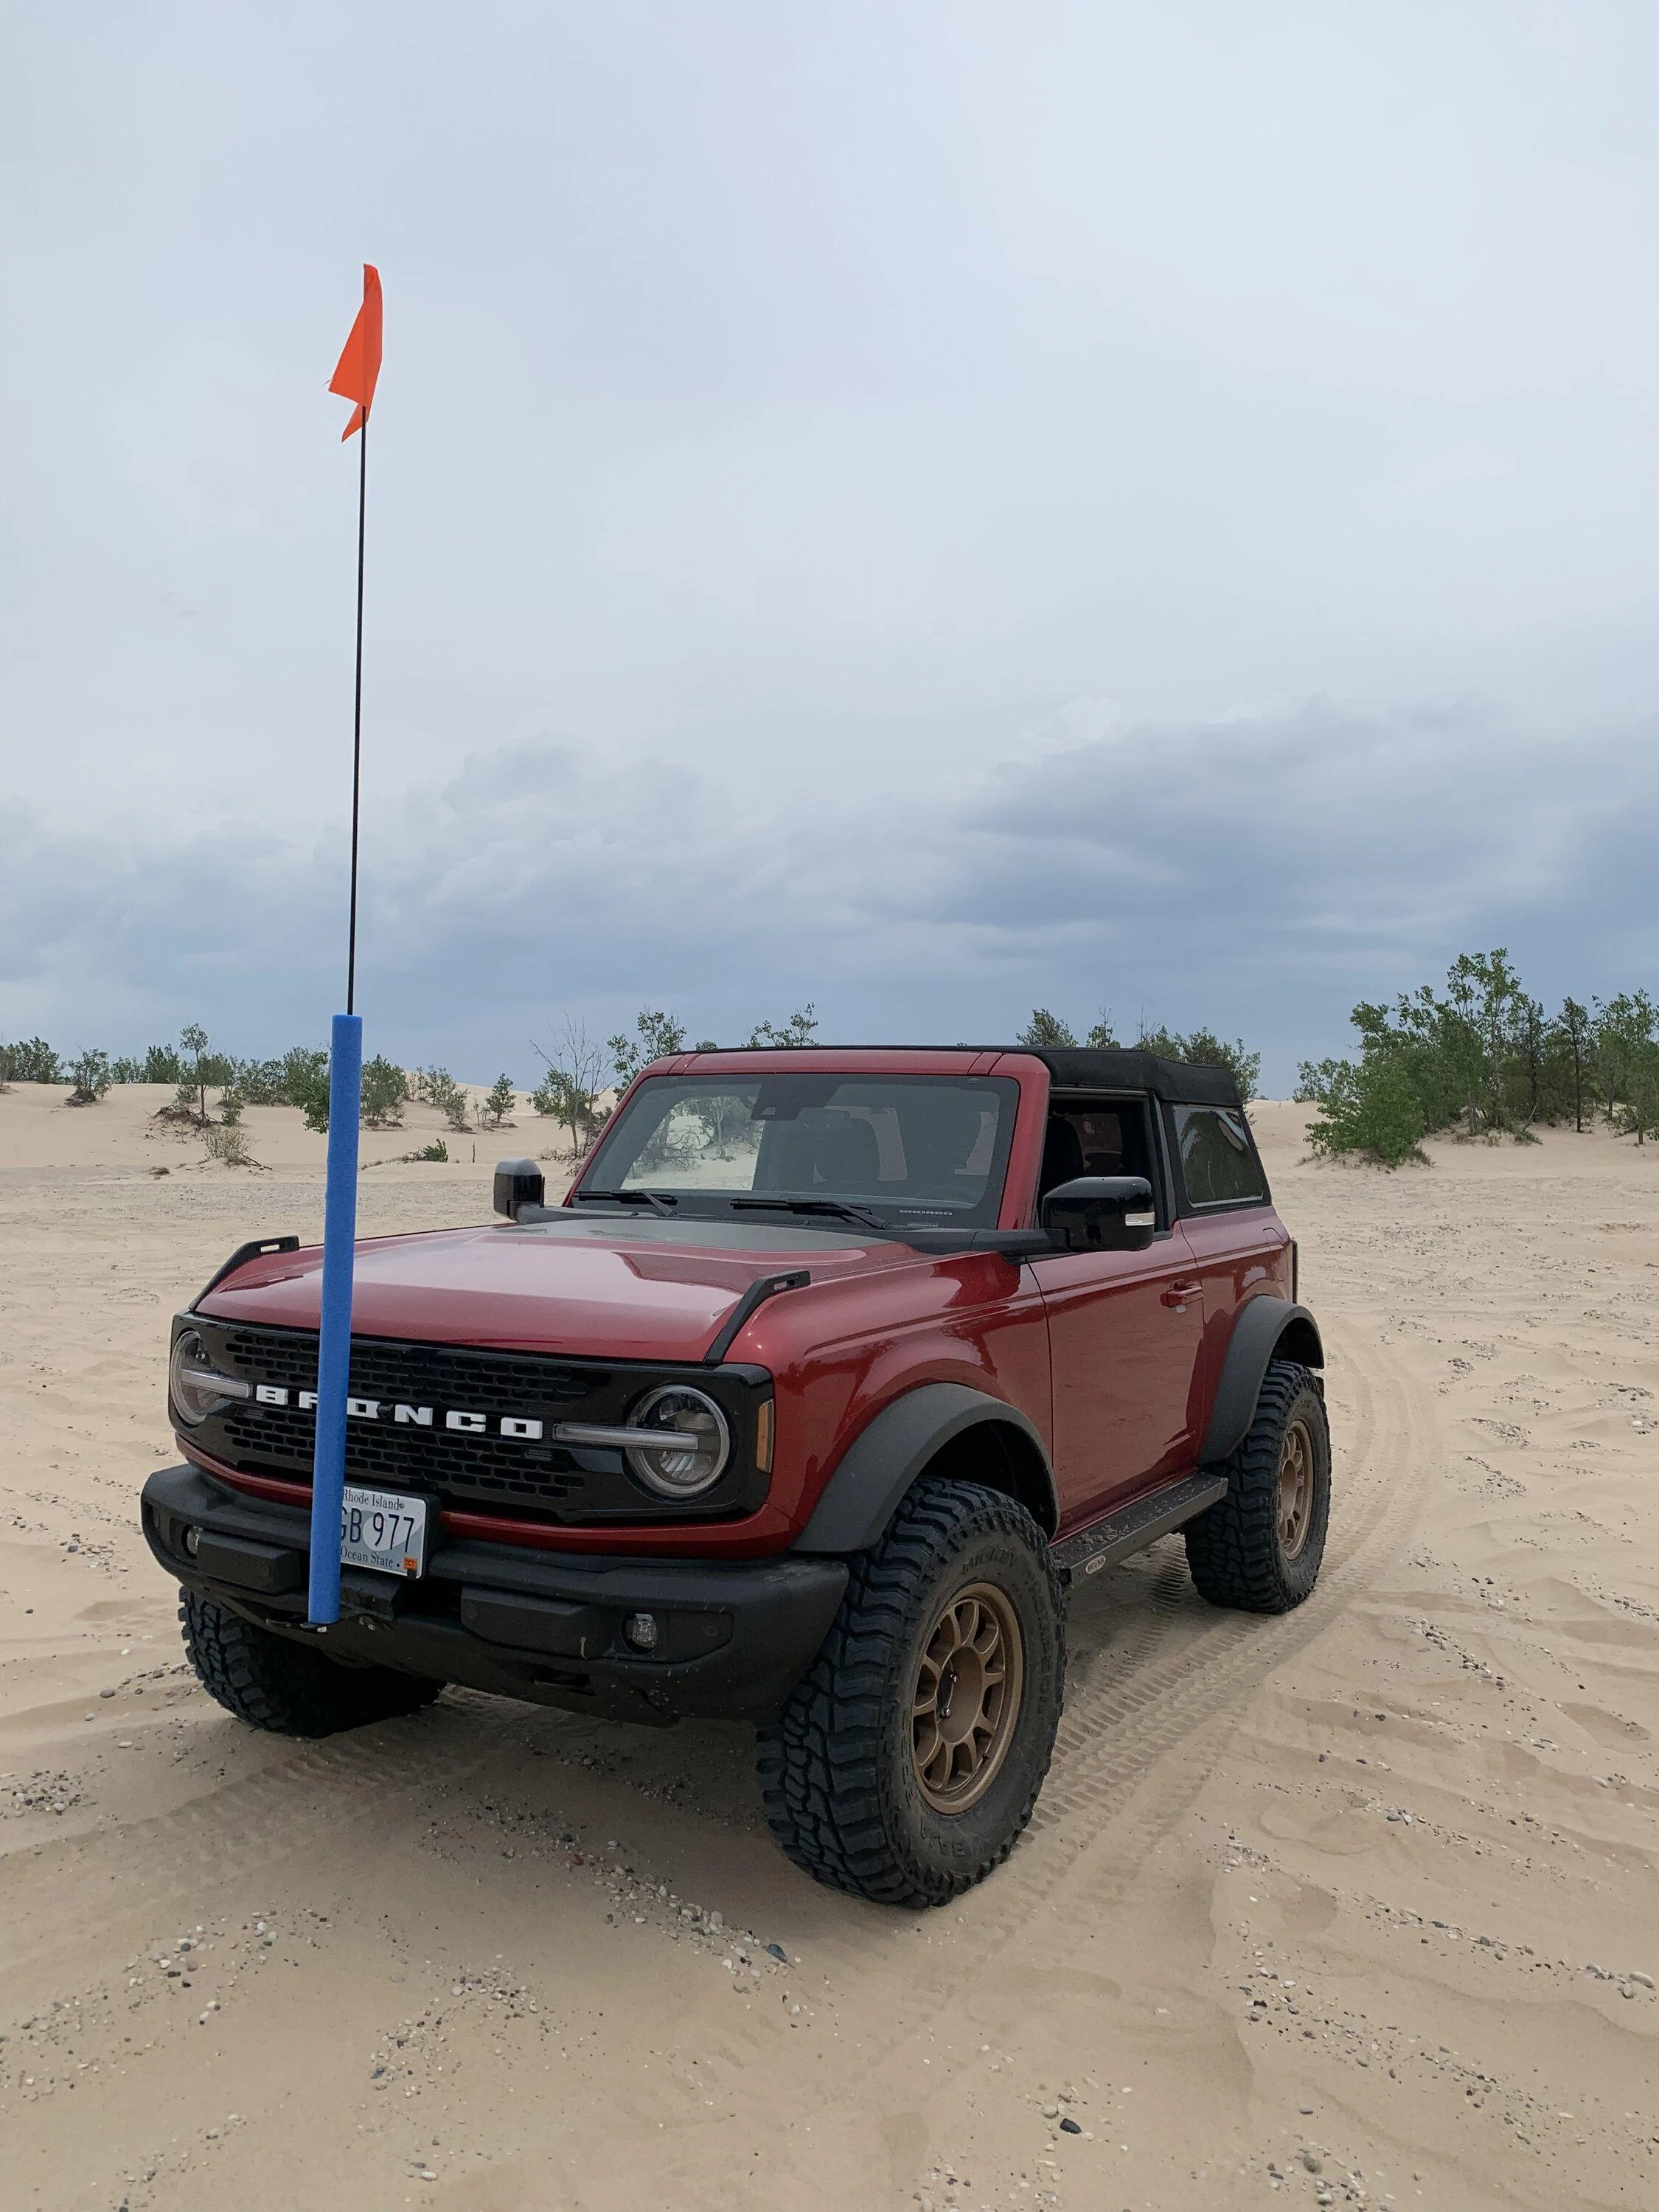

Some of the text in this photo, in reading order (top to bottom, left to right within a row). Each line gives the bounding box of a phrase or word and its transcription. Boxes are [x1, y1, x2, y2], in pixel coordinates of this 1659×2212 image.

[344, 1489, 400, 1511] Rhode Island
[373, 1512, 415, 1553] 977
[341, 1545, 394, 1568] Ocean State
